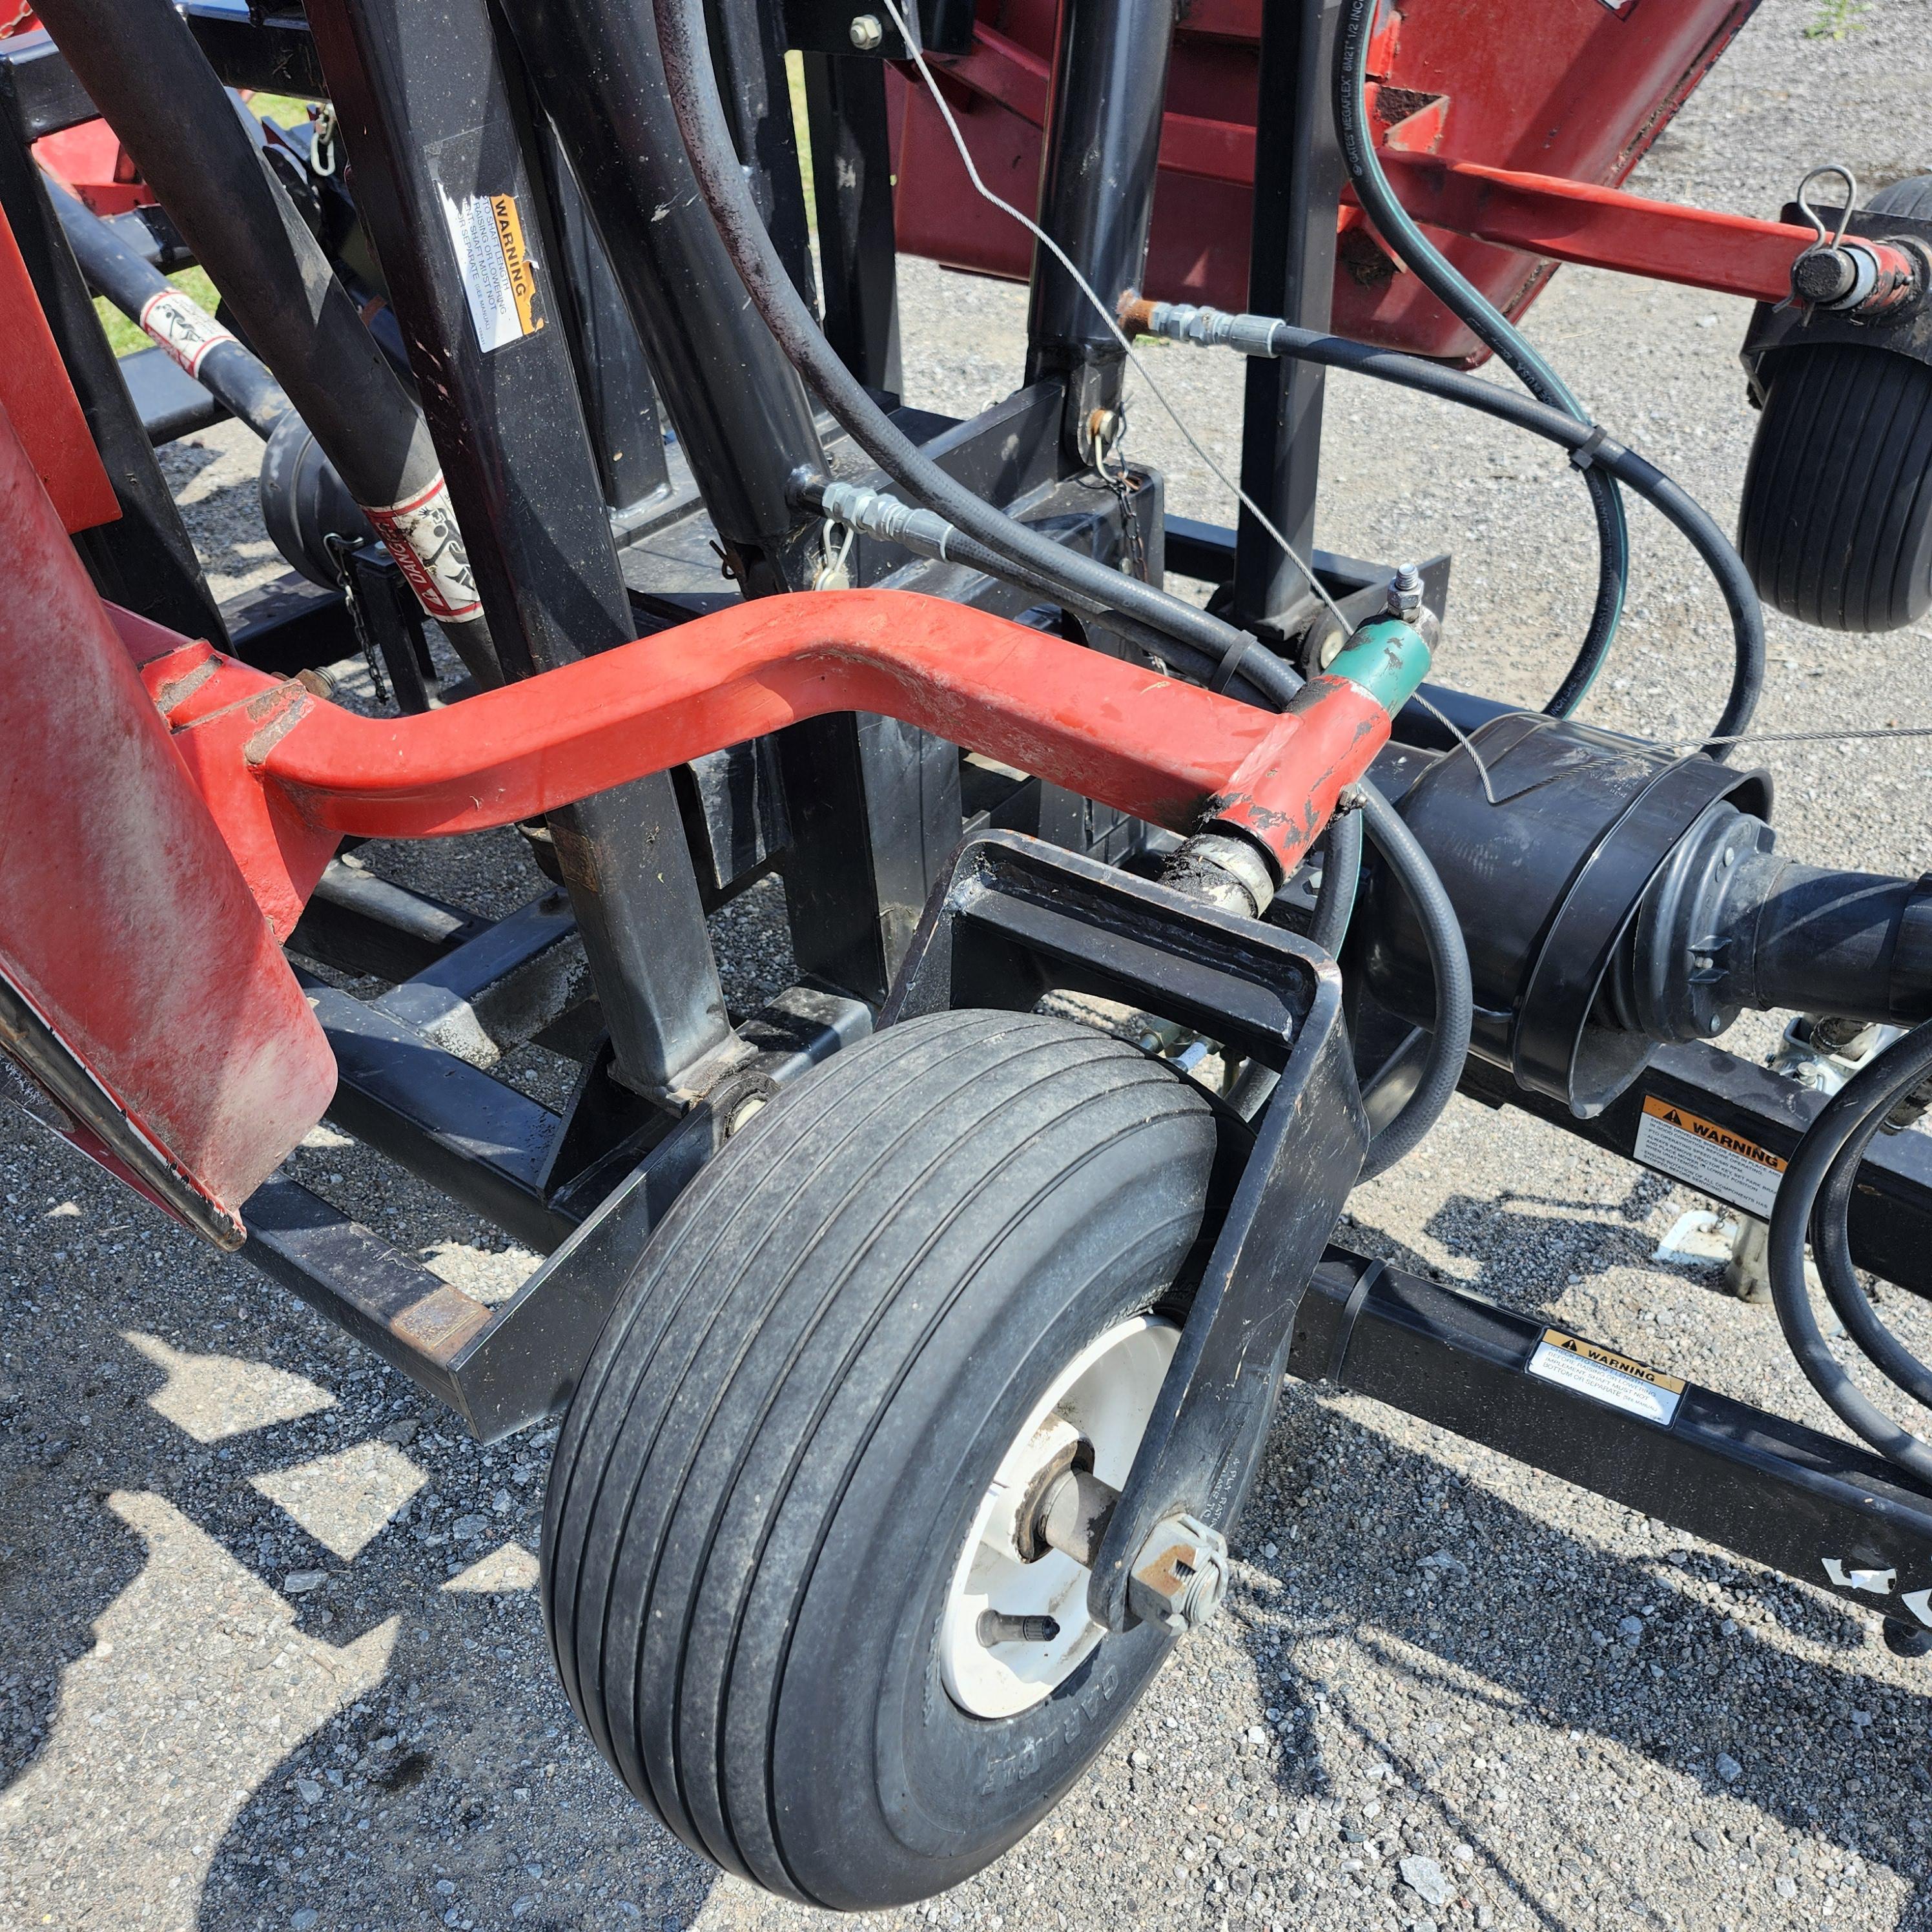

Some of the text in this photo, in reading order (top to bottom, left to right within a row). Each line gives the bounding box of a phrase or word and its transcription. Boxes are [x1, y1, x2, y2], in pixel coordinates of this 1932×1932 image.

[1352, 0, 1364, 25] INC
[460, 229, 479, 279] SEPARATE
[473, 201, 506, 314] RAISING OR LOWERING
[486, 216, 499, 247] SHAFT
[494, 251, 509, 291] LENGTH
[493, 198, 527, 297] WARNING
[469, 225, 483, 257] SHAFT
[478, 260, 491, 288] MUST
[486, 291, 496, 311] NOT
[1645, 1143, 1661, 1153] WHEN
[1647, 1134, 1669, 1146] ALWAYS
[1669, 1144, 1692, 1157] REMOVE
[1693, 1155, 1720, 1169] TRACTOR
[1660, 1133, 1691, 1150] OPERATING
[1692, 1148, 1711, 1159] SPEED
[1674, 1133, 1704, 1149] CONDITION
[1705, 1147, 1728, 1160] BEFORE
[1692, 1122, 1779, 1168] WARNING
[1643, 1154, 1668, 1167] STOPPED
[1669, 1166, 1690, 1178] BEFORE
[1644, 1150, 1665, 1162] ENSURE
[1666, 1160, 1694, 1175] ROTATION
[1715, 1182, 1754, 1202] COMPONENTS
[1659, 1145, 1676, 1155] PLACE
[1677, 1153, 1698, 1165] MOWER
[1706, 1166, 1729, 1179] LOWEST
[1731, 1177, 1758, 1192] POSITION
[1748, 1161, 1767, 1171] PLACE
[1542, 1362, 1572, 1377] BOTTOM
[1573, 1373, 1585, 1382] OR
[1585, 1379, 1621, 1397] SEPARATE
[1545, 1356, 1649, 1401] IMPLEMENT. SHAFT MUST NOT
[1547, 1351, 1657, 1397] BEFORE RAISING OR LOWERING
[1550, 1346, 1643, 1385] CHECK PTO SHAFT LENGTH
[1587, 1350, 1656, 1382] WARNING
[1224, 1470, 1237, 1494] PLY
